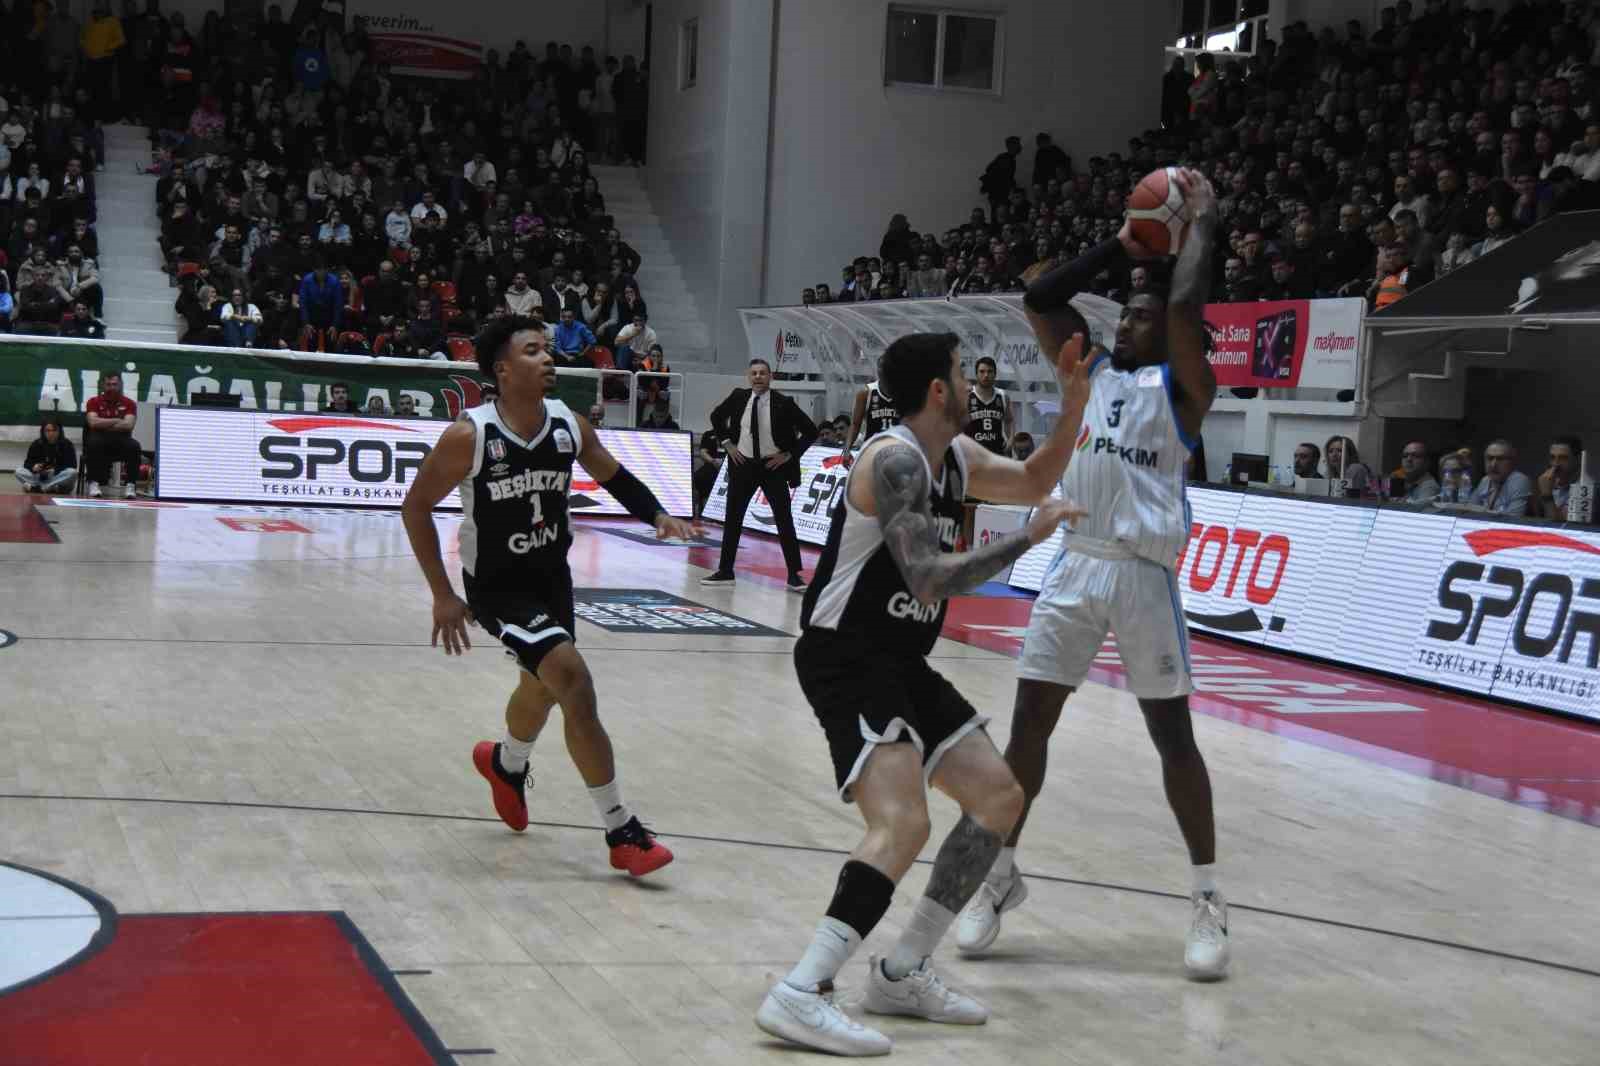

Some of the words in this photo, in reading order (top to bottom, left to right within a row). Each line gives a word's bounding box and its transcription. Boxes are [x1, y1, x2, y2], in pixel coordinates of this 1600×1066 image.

[1229, 325, 1251, 342] Sana
[982, 418, 992, 431] 6
[1106, 399, 1125, 428] 3
[262, 484, 334, 496] TEŞKİLAT
[486, 468, 568, 501] BEŞİKTA
[529, 492, 545, 525] 1
[1418, 650, 1488, 679] TEŞKİLAT
